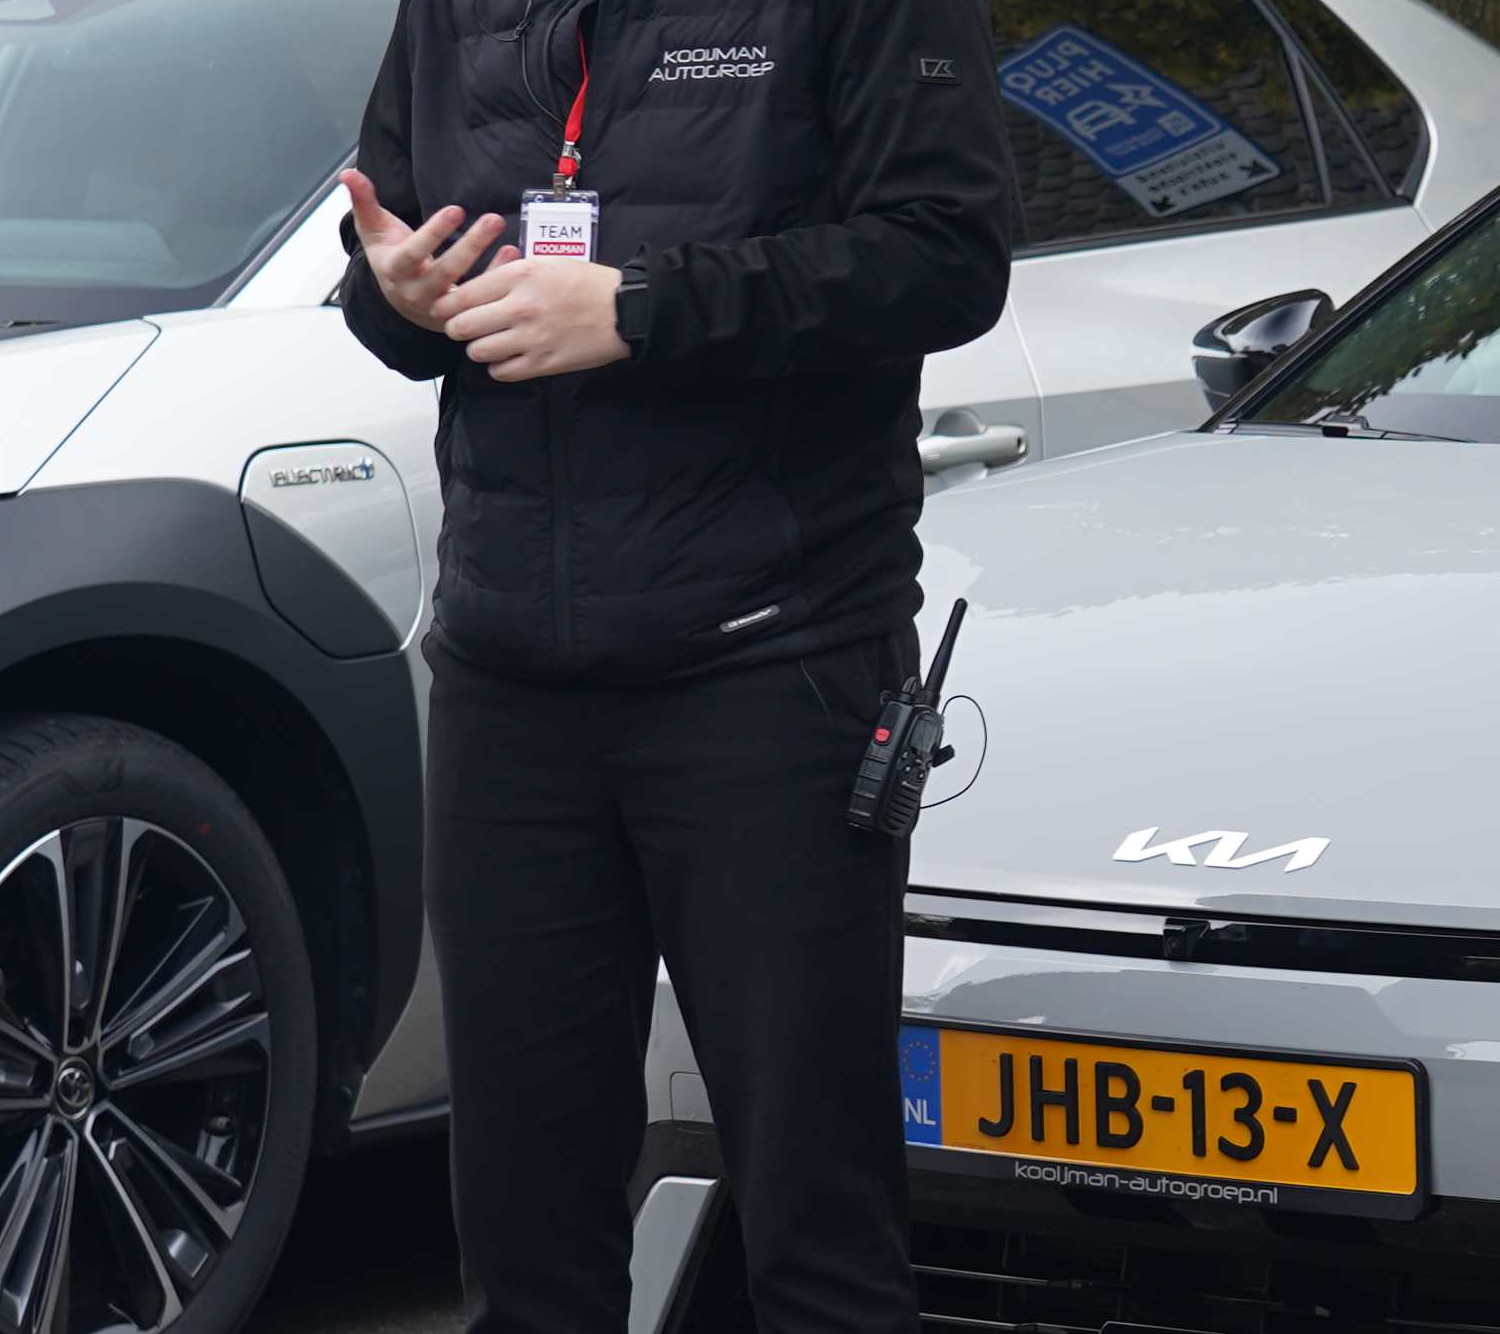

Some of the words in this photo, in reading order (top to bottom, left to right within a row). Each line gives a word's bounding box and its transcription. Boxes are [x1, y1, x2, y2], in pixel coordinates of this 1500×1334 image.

[663, 45, 767, 65] KOOIJMAN
[648, 61, 775, 82] AUTOGROEP
[539, 225, 582, 238] TEAM
[904, 1097, 936, 1126] NL
[978, 1052, 1360, 1171] JHB-13-X
[1014, 1160, 1278, 1205] kooijman-autogroep.nl
